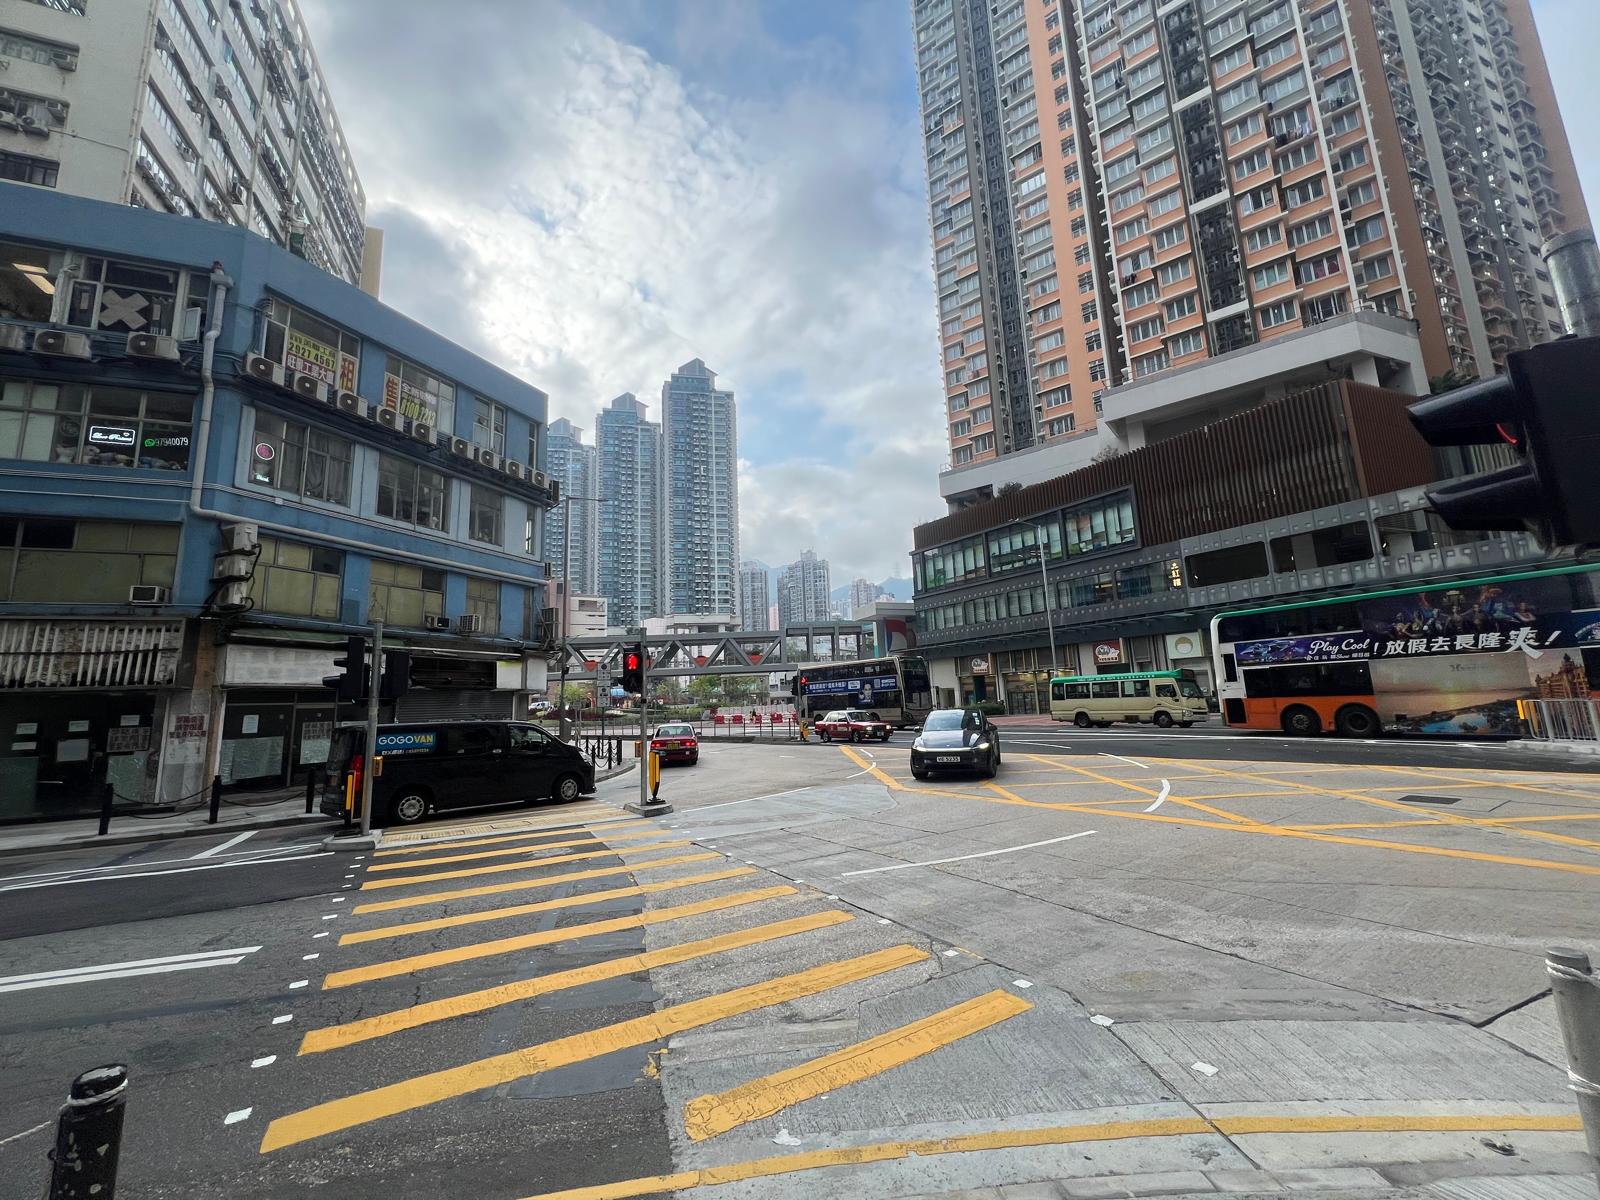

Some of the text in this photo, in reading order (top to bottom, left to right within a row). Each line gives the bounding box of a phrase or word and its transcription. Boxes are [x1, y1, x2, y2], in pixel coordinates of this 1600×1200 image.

[288, 342, 336, 369] 2927 4567
[340, 358, 355, 391] 租
[386, 377, 398, 411] 售
[155, 437, 189, 446] 97940079
[1308, 640, 1339, 654] Play
[1341, 638, 1370, 650] Cool
[378, 735, 433, 745] GOGOVAN
